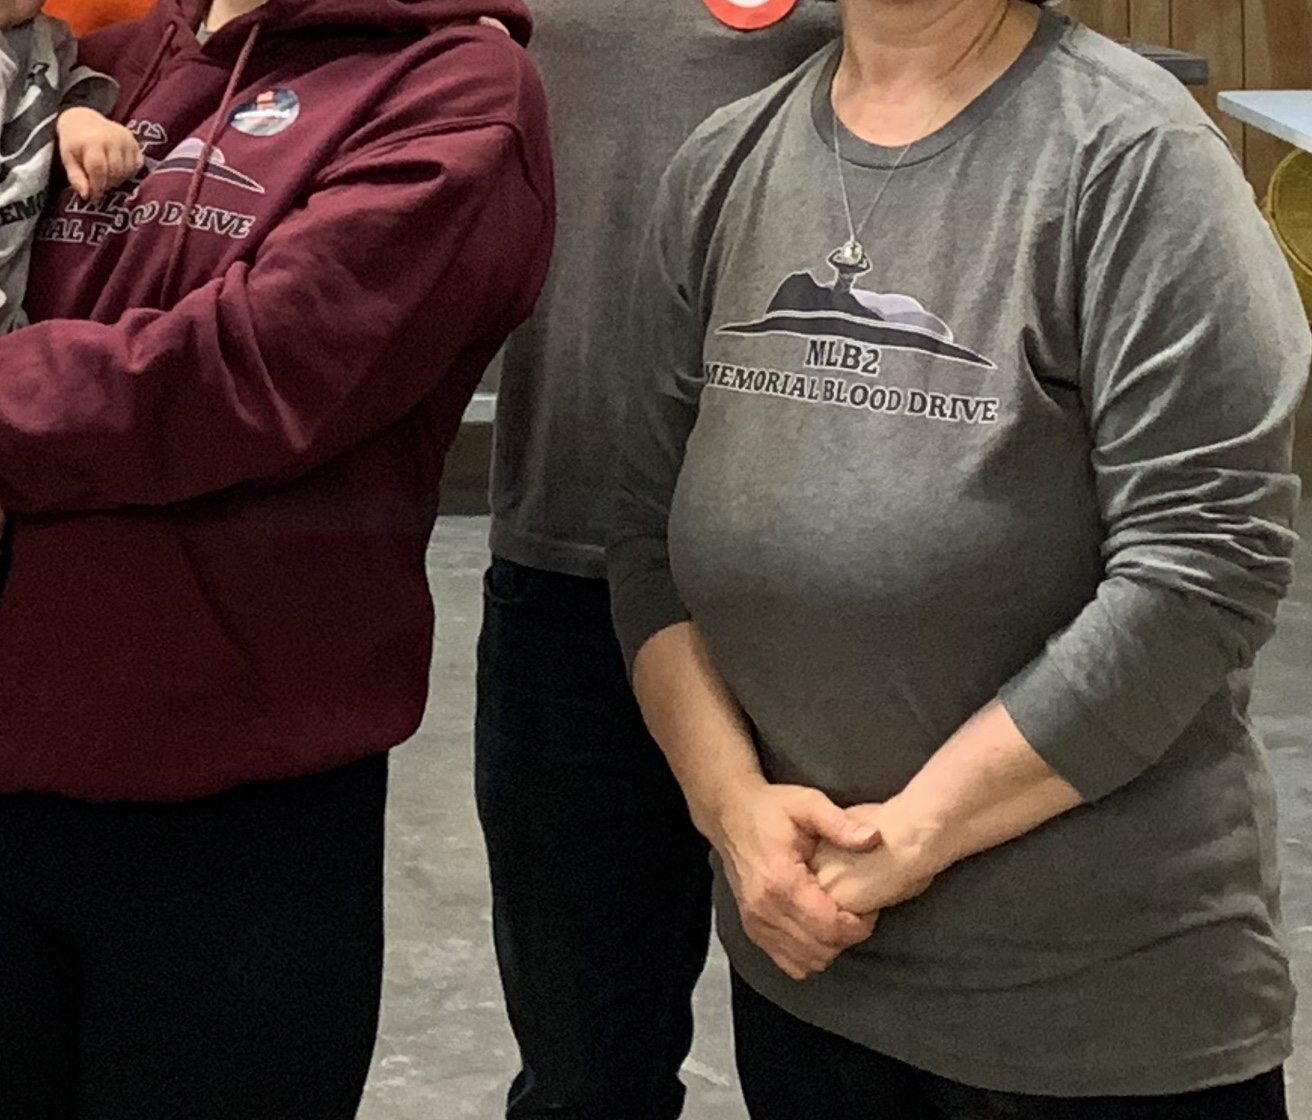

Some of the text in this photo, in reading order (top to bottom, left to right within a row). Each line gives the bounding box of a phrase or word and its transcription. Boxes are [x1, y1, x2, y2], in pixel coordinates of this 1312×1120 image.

[705, 362, 998, 423] MEMORIAL BLOOD DRIVE
